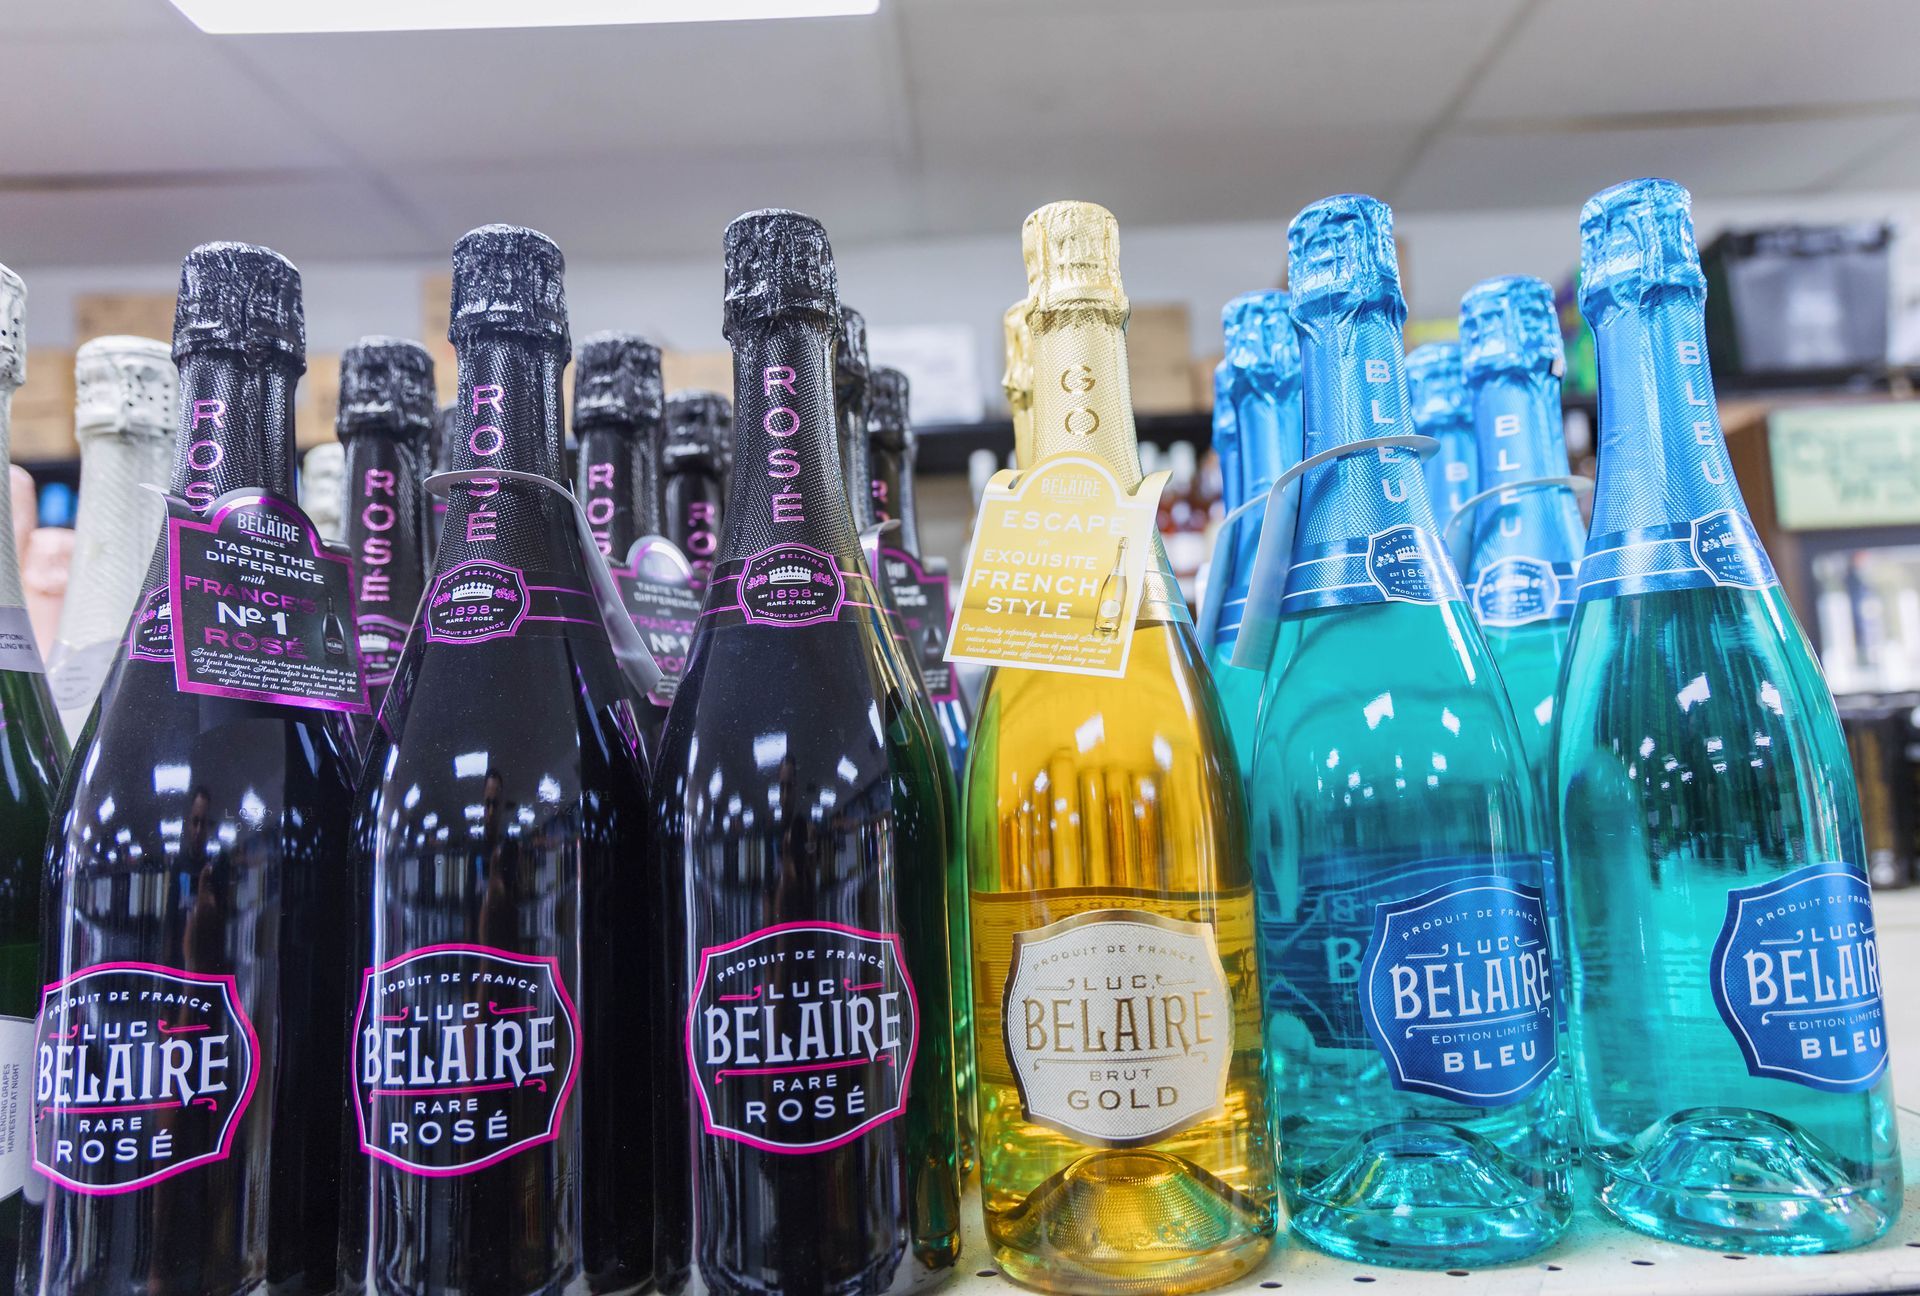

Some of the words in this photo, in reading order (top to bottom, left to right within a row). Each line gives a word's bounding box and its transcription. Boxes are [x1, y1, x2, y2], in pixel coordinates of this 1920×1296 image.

[1677, 341, 1726, 486] BLEU
[1365, 360, 1408, 503] BLEU
[763, 366, 805, 524] ROSÉ
[238, 513, 299, 542] BELAIRE
[259, 512, 279, 521] LUC
[1002, 509, 1127, 536] ESCAPE
[215, 539, 275, 562] TASTE
[280, 554, 315, 570] THE
[251, 536, 286, 549] FRANCE
[1381, 537, 1398, 549] LUC
[206, 551, 324, 584] DIFFERENCE
[755, 557, 774, 571] LUC
[779, 553, 824, 569] BELAIRE
[983, 549, 1098, 571] EXQUISITE
[240, 574, 265, 585] with
[464, 570, 510, 584] BELAIRE
[971, 569, 1100, 597] FRENCH
[770, 588, 812, 600] 1898
[450, 605, 490, 617] 1898
[755, 608, 787, 618] PRODUIT
[985, 597, 1073, 620] STYLE
[272, 612, 288, 635] 1
[204, 627, 308, 660] ROSÉ
[191, 648, 217, 657] Fresh
[278, 662, 301, 670] elegant
[1756, 897, 1821, 927] PRODUIT
[1828, 895, 1842, 905] DE
[1402, 912, 1469, 941] PRODUIT
[1477, 909, 1493, 918] DE
[1501, 908, 1539, 926] FRANCE
[1811, 923, 1856, 942] LUC
[1033, 946, 1097, 971] PRODUIT
[1107, 945, 1126, 953] DE
[1138, 944, 1196, 964] FRANCE
[1457, 936, 1510, 957] LUC
[717, 953, 785, 983] PRODUIT
[796, 950, 815, 960] DE
[826, 950, 885, 969] FRANCE
[1743, 936, 1883, 1006] BELAIR
[441, 973, 461, 982] DE
[472, 973, 538, 993] FRANCE
[769, 979, 835, 1000] LUC
[1084, 974, 1148, 991] LUC
[1389, 948, 1552, 1020] BELAIRE
[49, 993, 101, 1019] PRODUIT
[110, 991, 129, 1001] DE
[141, 991, 212, 1012] FRANCE
[415, 1002, 479, 1021] LUC
[83, 1021, 147, 1040] LUC
[704, 991, 901, 1064] BELAIRE
[1022, 989, 1214, 1057] BELAIRE
[363, 1016, 556, 1087] BELAIRE
[1801, 1027, 1881, 1060] BLEU
[1443, 1040, 1536, 1073] BLEU
[2, 1064, 10, 1097] GRAPES
[11, 1064, 19, 1088] NIGHT
[38, 1034, 230, 1106] BELAIRE
[1090, 1068, 1152, 1082] BRUT
[11, 1091, 17, 1100] AT
[773, 1074, 837, 1093] RARE
[415, 1098, 478, 1114] RARE
[746, 1085, 866, 1123] ROSÉ
[1067, 1086, 1179, 1110] GOLD
[7, 1103, 17, 1153] HARVESTED
[79, 1117, 142, 1133] RARE
[391, 1110, 508, 1145] ROSÉ
[56, 1129, 173, 1163] ROSÉ
